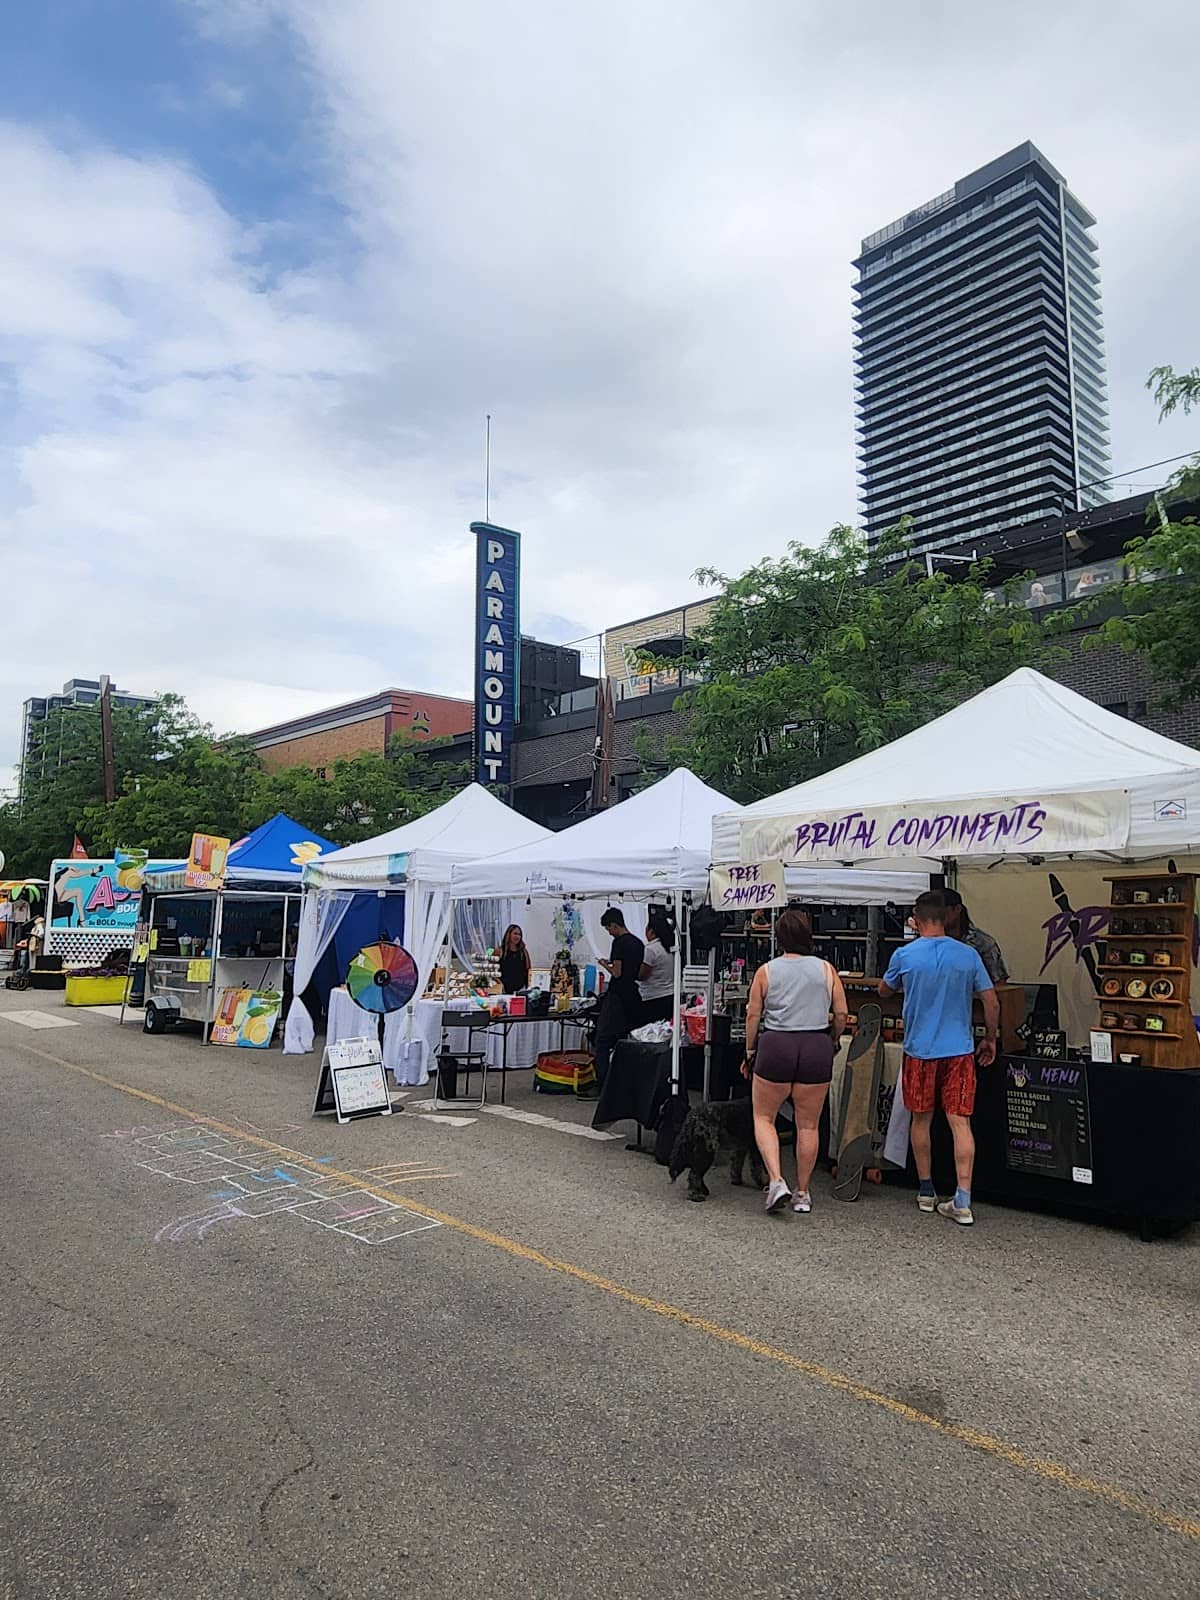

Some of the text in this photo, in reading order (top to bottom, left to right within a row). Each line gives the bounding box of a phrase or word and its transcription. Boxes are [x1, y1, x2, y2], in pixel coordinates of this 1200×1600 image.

[484, 539, 506, 781] PARAMOUNT
[793, 801, 1048, 857] BRUTAL CONDIMENTS
[728, 863, 762, 885] FREE
[722, 883, 777, 907] SAMPLES
[96, 918, 116, 927] BOLD
[1045, 1033, 1061, 1043] OFF
[1040, 1066, 1080, 1088] MENU
